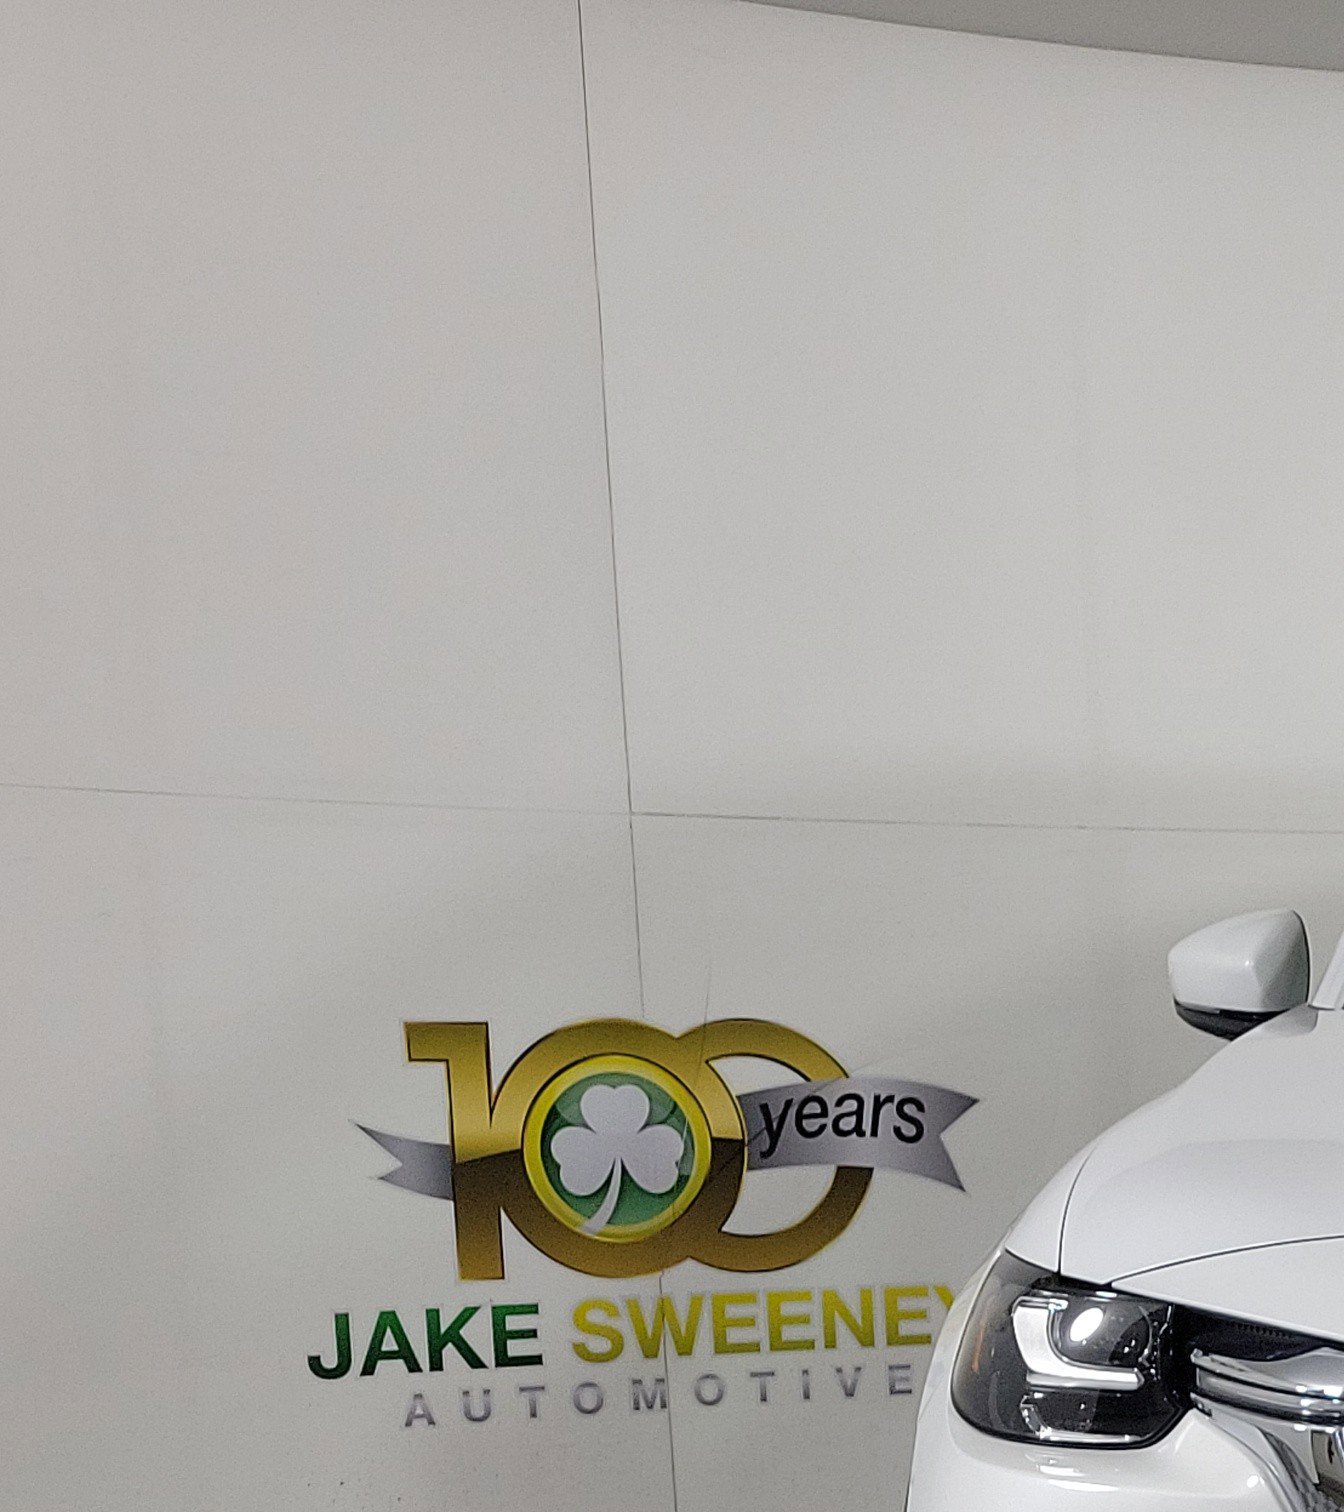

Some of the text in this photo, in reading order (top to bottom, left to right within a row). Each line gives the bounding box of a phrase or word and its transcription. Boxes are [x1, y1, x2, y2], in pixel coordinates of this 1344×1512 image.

[404, 1017, 927, 1282] 100 years
[307, 1302, 544, 1380] JAKE
[403, 1363, 913, 1428] AUTOMOTIVE
